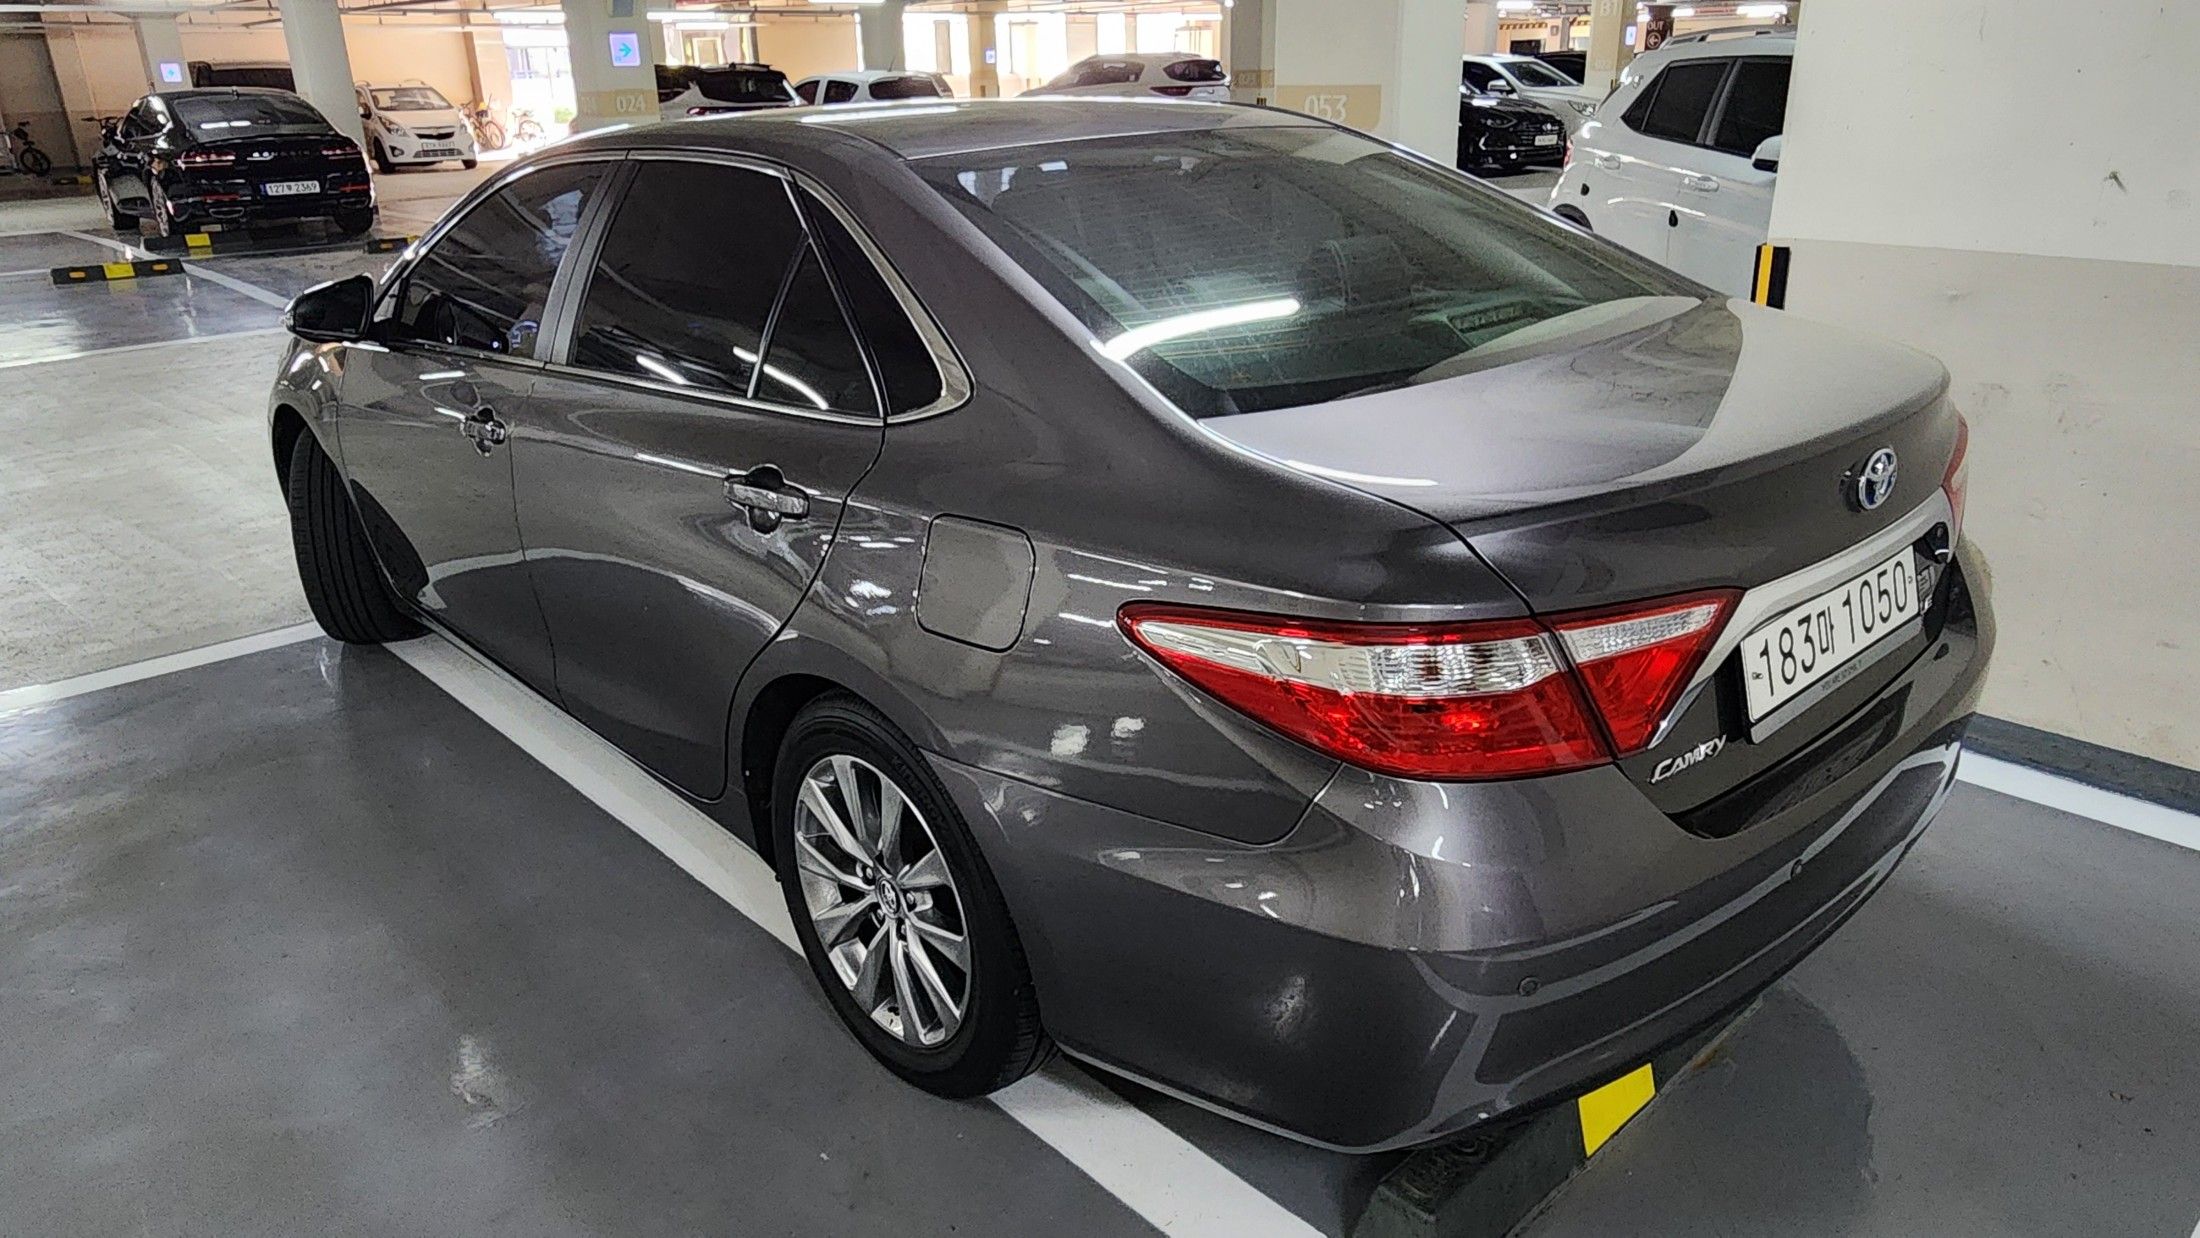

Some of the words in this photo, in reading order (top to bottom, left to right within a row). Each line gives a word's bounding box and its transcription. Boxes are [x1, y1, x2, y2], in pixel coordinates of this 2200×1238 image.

[1648, 21, 1664, 30] OUT
[616, 95, 646, 113] 024
[1304, 94, 1347, 122] 053
[1759, 605, 1835, 697] 183마
[1842, 560, 1908, 644] 1050
[1650, 734, 1727, 784] CAMRY
